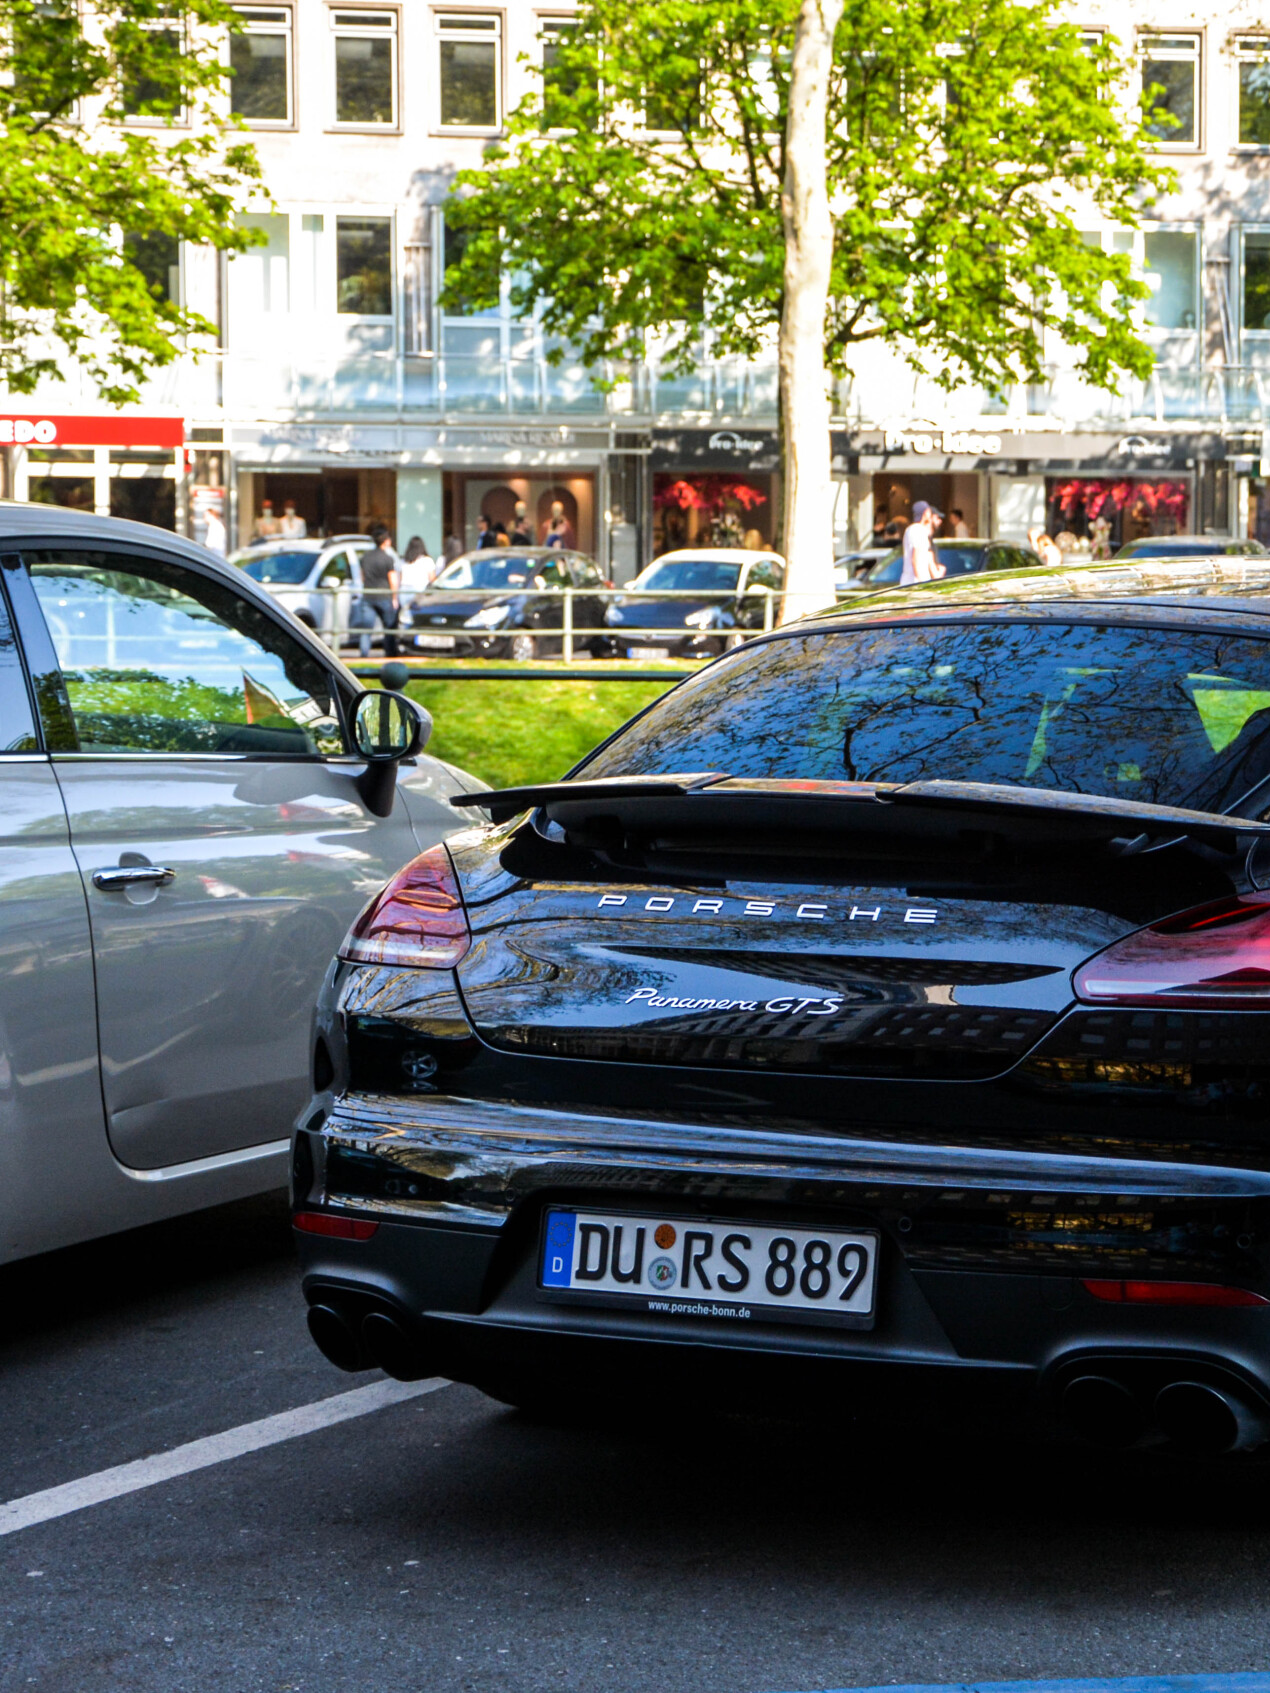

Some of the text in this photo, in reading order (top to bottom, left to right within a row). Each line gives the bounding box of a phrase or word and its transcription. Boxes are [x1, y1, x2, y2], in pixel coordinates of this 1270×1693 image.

[597, 894, 938, 924] PORSCHE
[625, 987, 845, 1016] Panamera GTS
[552, 1256, 564, 1273] D
[575, 1222, 646, 1284] DU
[681, 1230, 751, 1292] RS
[765, 1236, 868, 1300] 889
[648, 1301, 751, 1318] www.porsche-bonn.de
